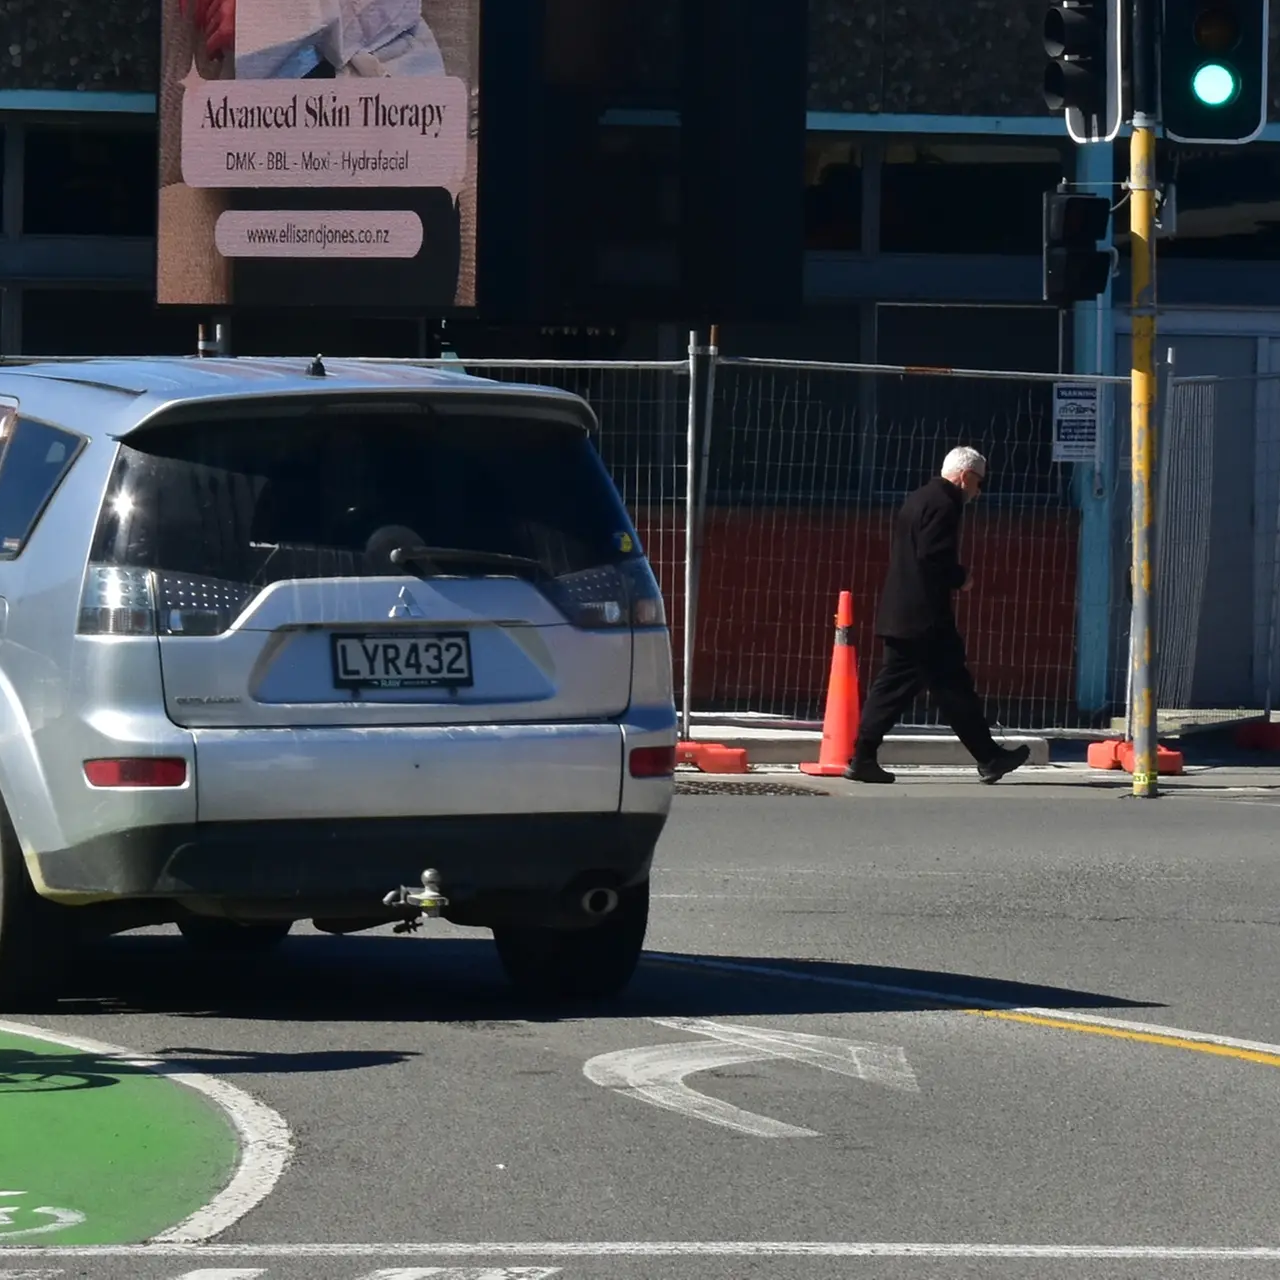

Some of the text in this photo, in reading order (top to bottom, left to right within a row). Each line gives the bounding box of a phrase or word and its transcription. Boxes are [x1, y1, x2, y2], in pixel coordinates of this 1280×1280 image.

[201, 91, 447, 138] Advanced Skin Therapy
[226, 151, 256, 171] DMK
[267, 151, 290, 171] BBL
[301, 151, 331, 171] Moxi
[341, 150, 409, 176] Hydrafacial
[246, 222, 390, 250] www.ellisandjones.co.nz
[340, 641, 466, 676] LYR432
